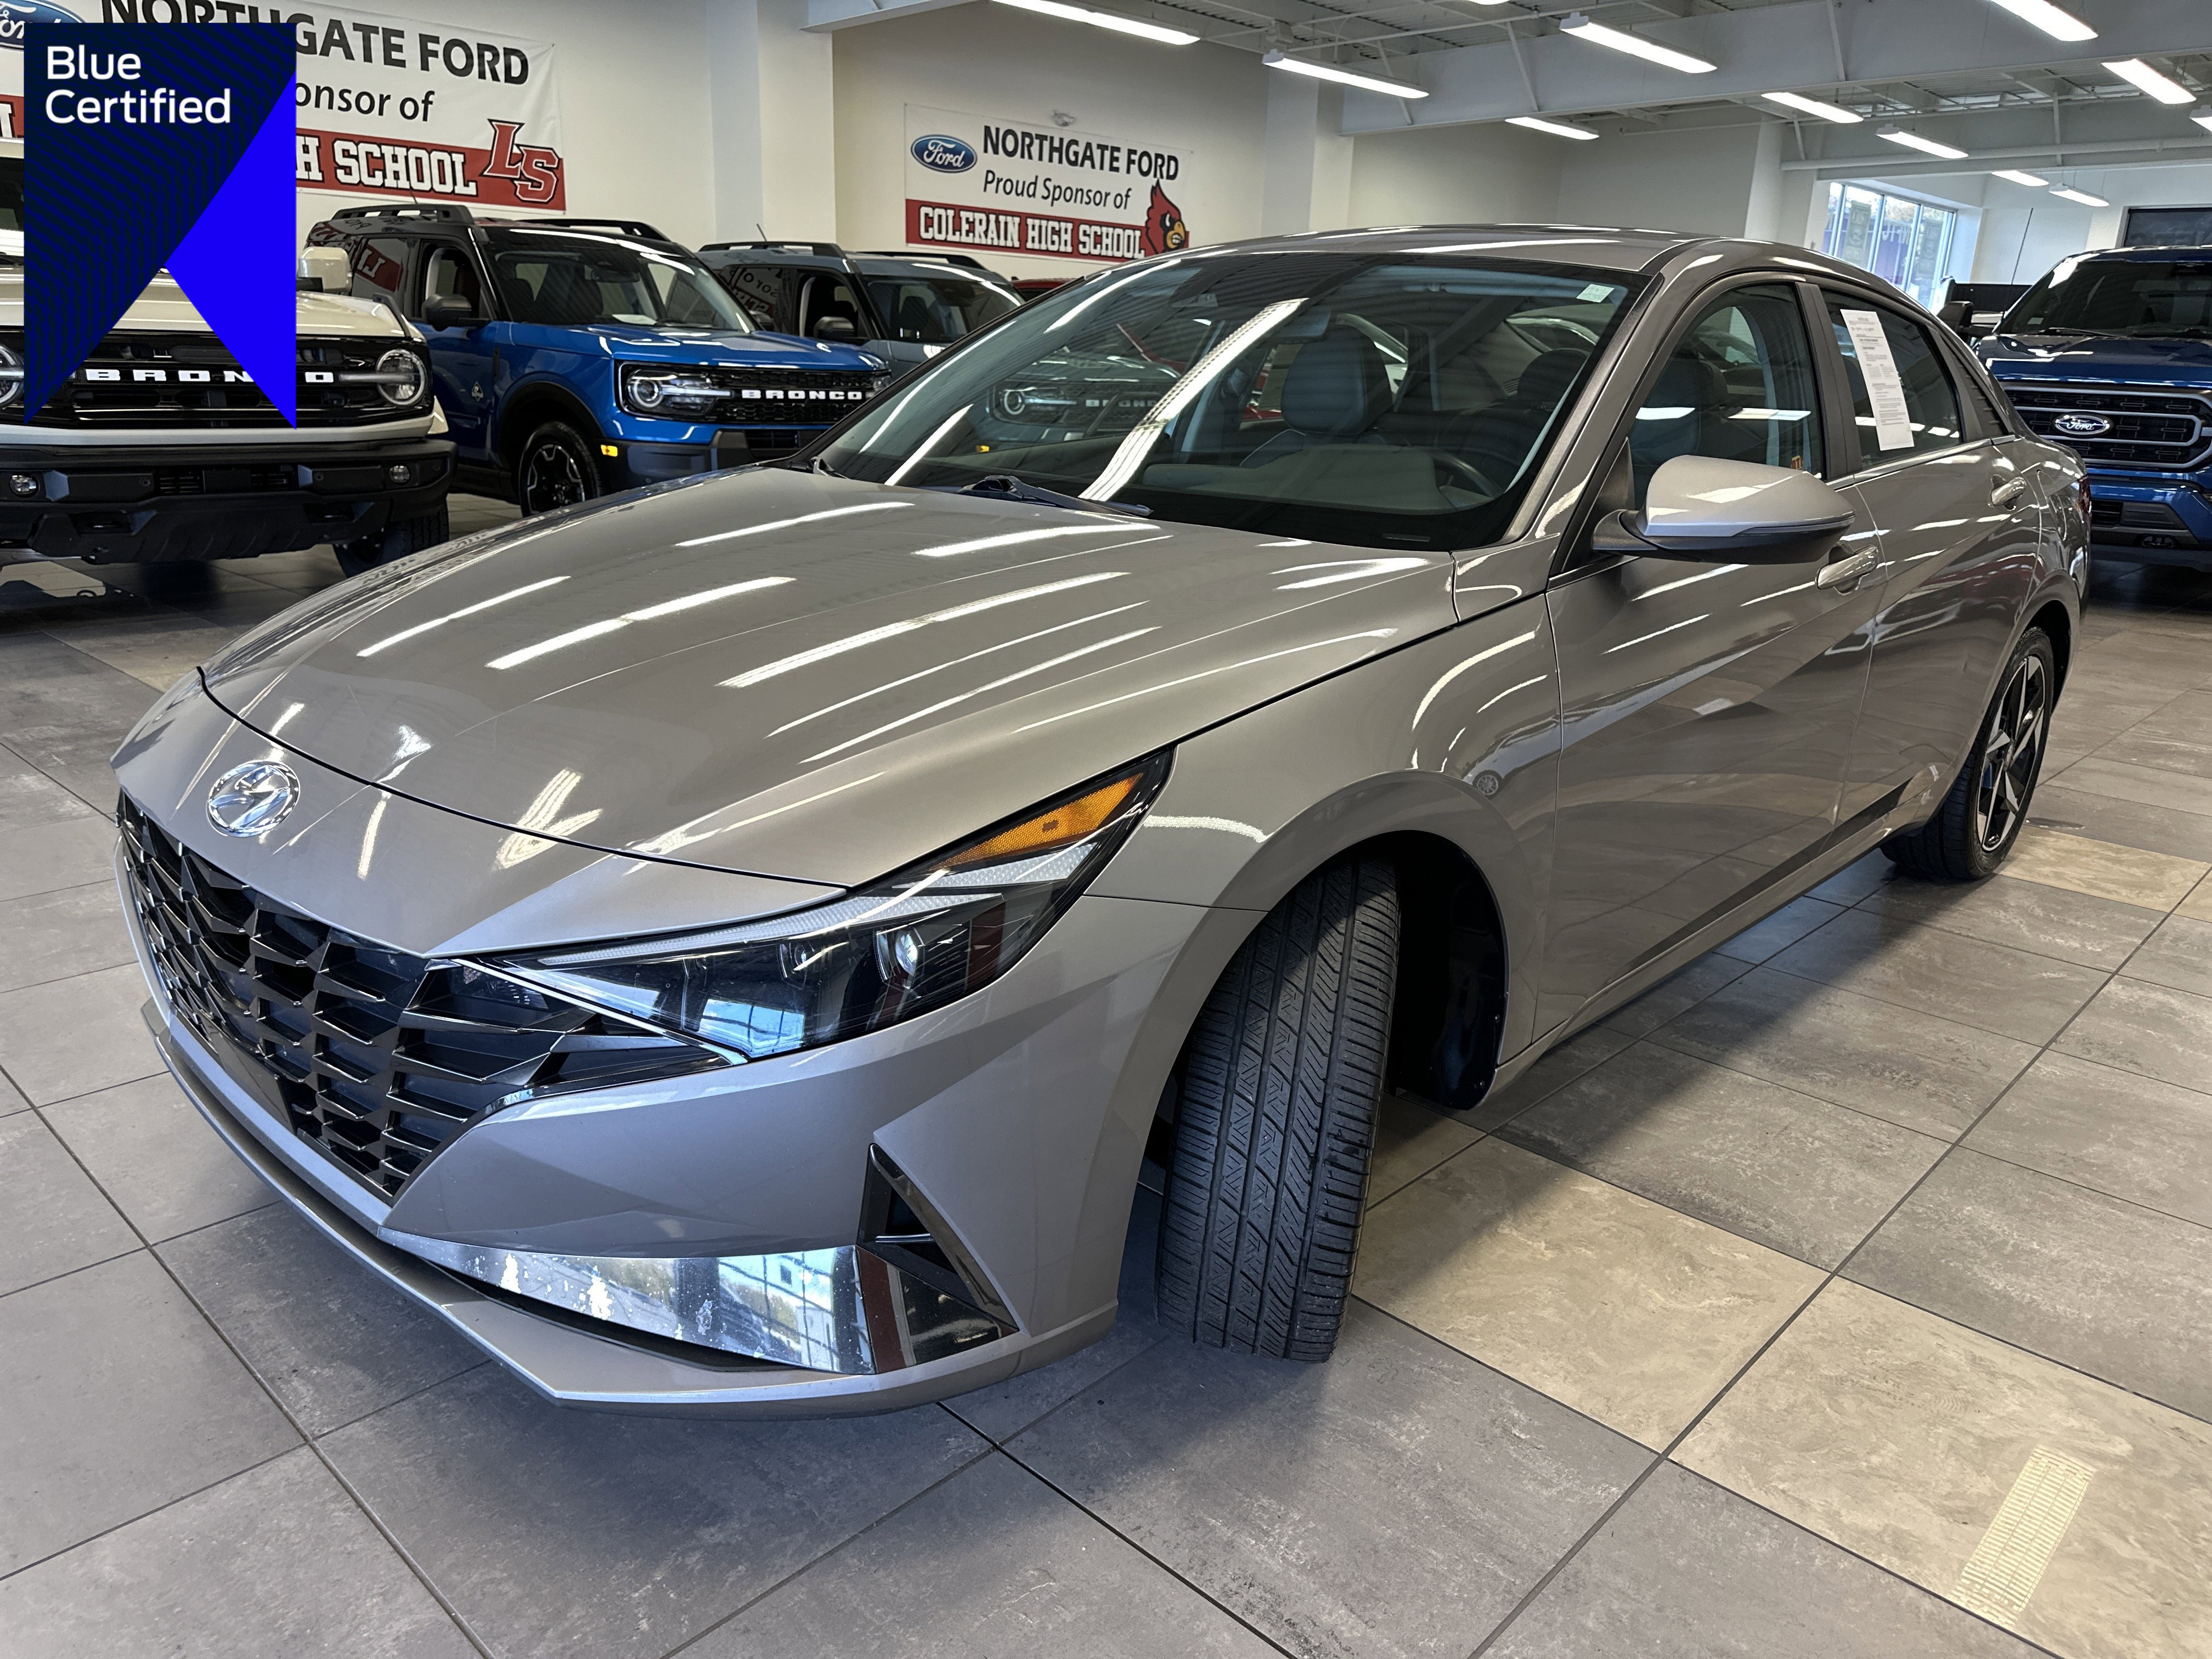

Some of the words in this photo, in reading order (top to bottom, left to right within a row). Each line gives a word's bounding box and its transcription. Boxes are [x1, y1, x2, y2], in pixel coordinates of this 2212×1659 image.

[419, 33, 529, 85] FORD
[399, 91, 436, 122] of
[332, 139, 477, 196] SCHOOL
[923, 140, 965, 168] Ford
[983, 126, 1121, 173] NORTHGATE
[1126, 149, 1179, 181] FORD
[984, 170, 1039, 199] Proud
[1041, 178, 1111, 207] Sponsor
[1113, 188, 1132, 210] of
[918, 206, 1020, 249] COLERAIN
[1026, 218, 1074, 253] HIGH
[1078, 223, 1146, 259] SCHOOL
[86, 369, 334, 383] BRONO
[742, 390, 862, 400] BRONCO
